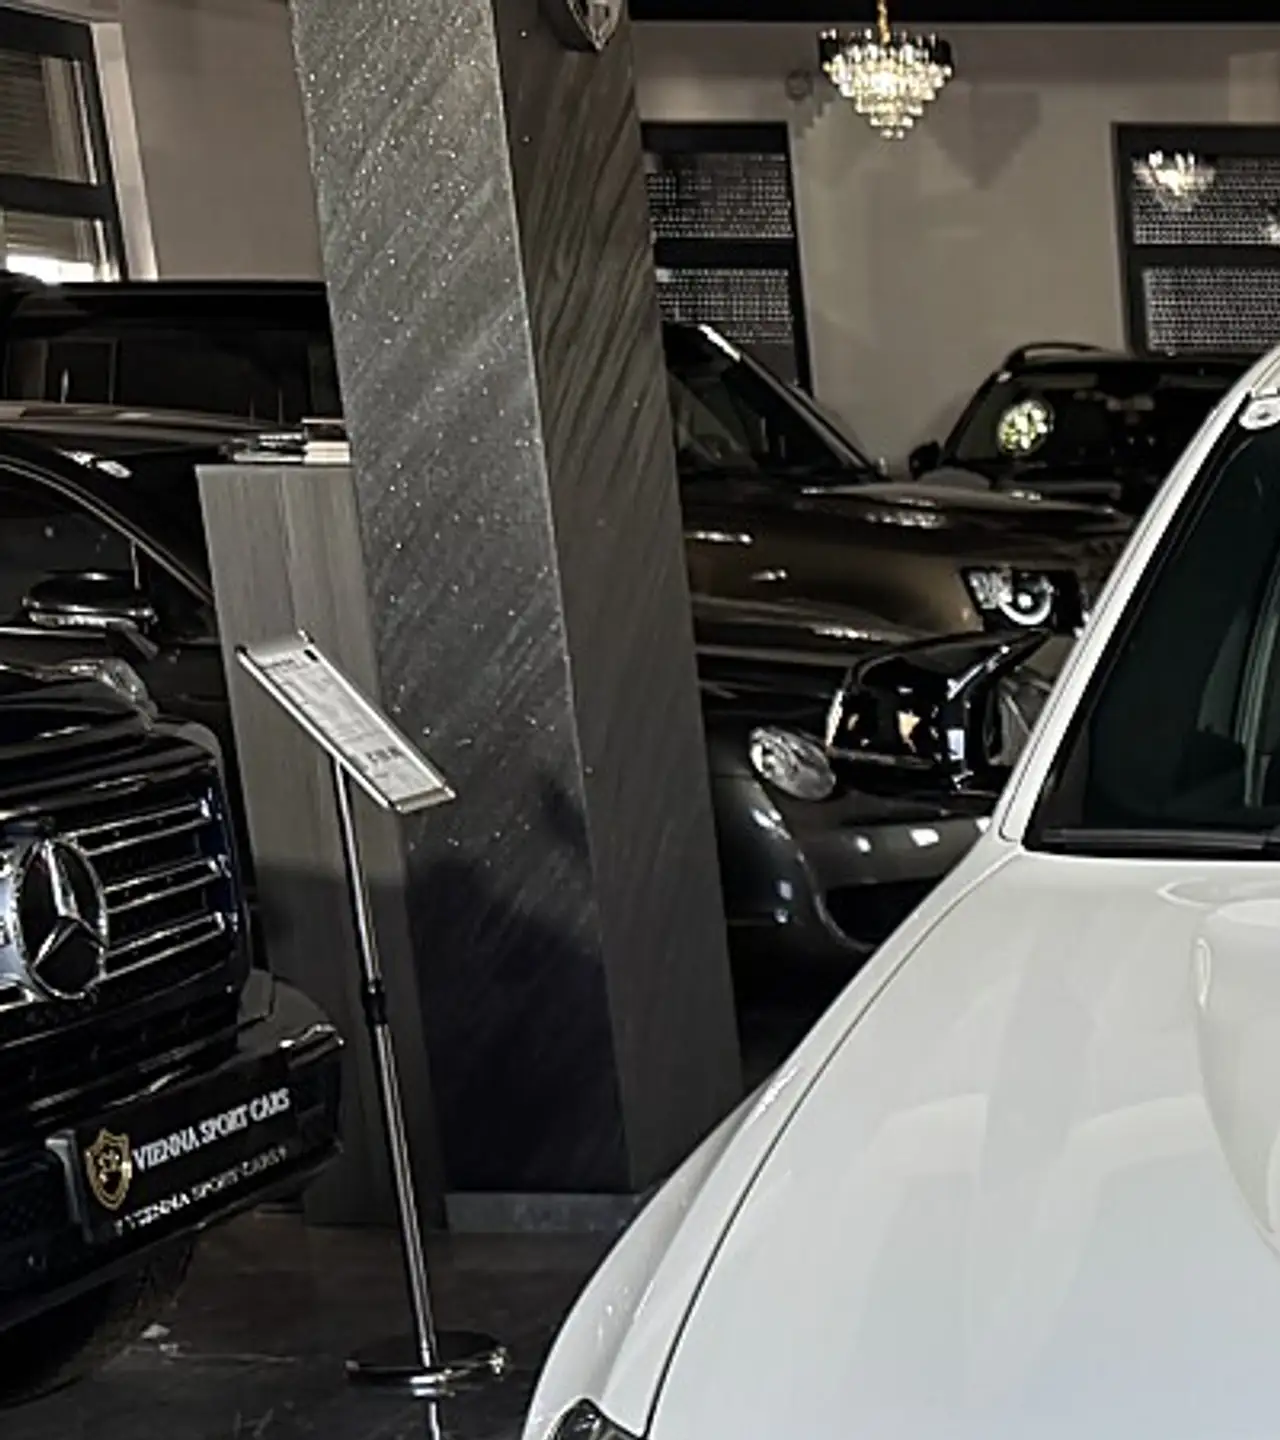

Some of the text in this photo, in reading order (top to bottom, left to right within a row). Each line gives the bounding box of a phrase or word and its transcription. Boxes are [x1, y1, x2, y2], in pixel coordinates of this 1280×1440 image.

[132, 1126, 200, 1172] VIENNA
[199, 1104, 248, 1144] SPORT
[249, 1087, 290, 1121] CARS
